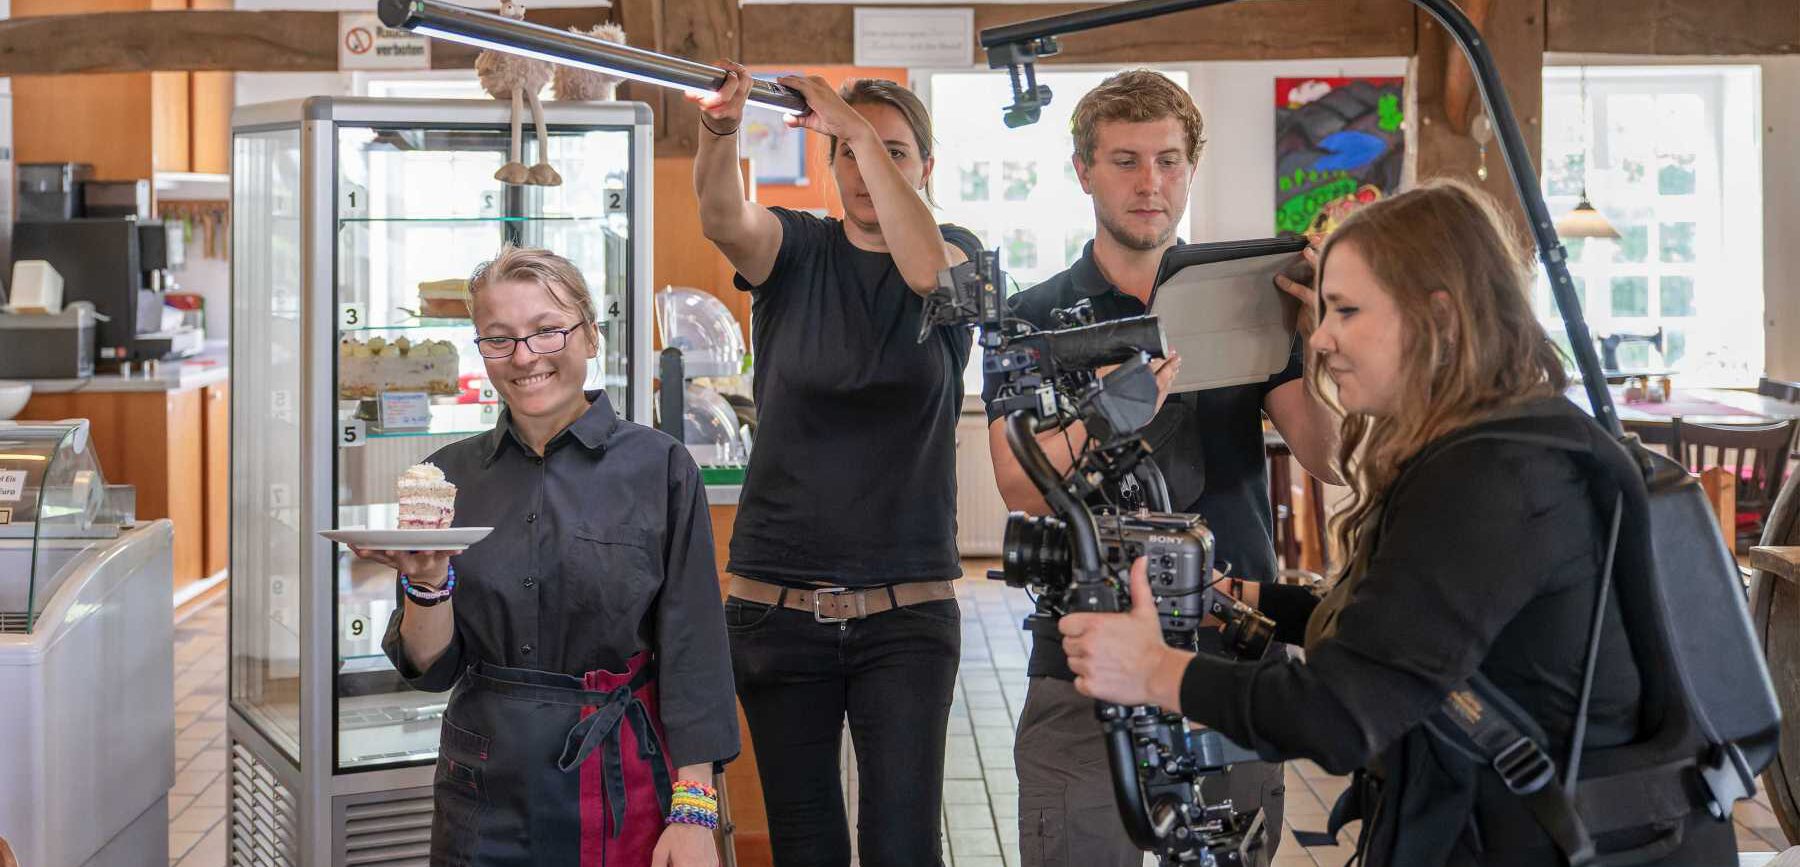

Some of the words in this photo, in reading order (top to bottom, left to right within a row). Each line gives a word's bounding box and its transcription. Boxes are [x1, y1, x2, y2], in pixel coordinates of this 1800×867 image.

[376, 43, 424, 55] verboten
[348, 191, 356, 208] 1
[609, 193, 621, 209] 2
[345, 308, 358, 325] 3
[608, 301, 620, 317] 4
[344, 426, 357, 442] 5
[5, 475, 16, 483] Eis
[1148, 534, 1184, 545] SONY
[352, 619, 363, 635] 9
